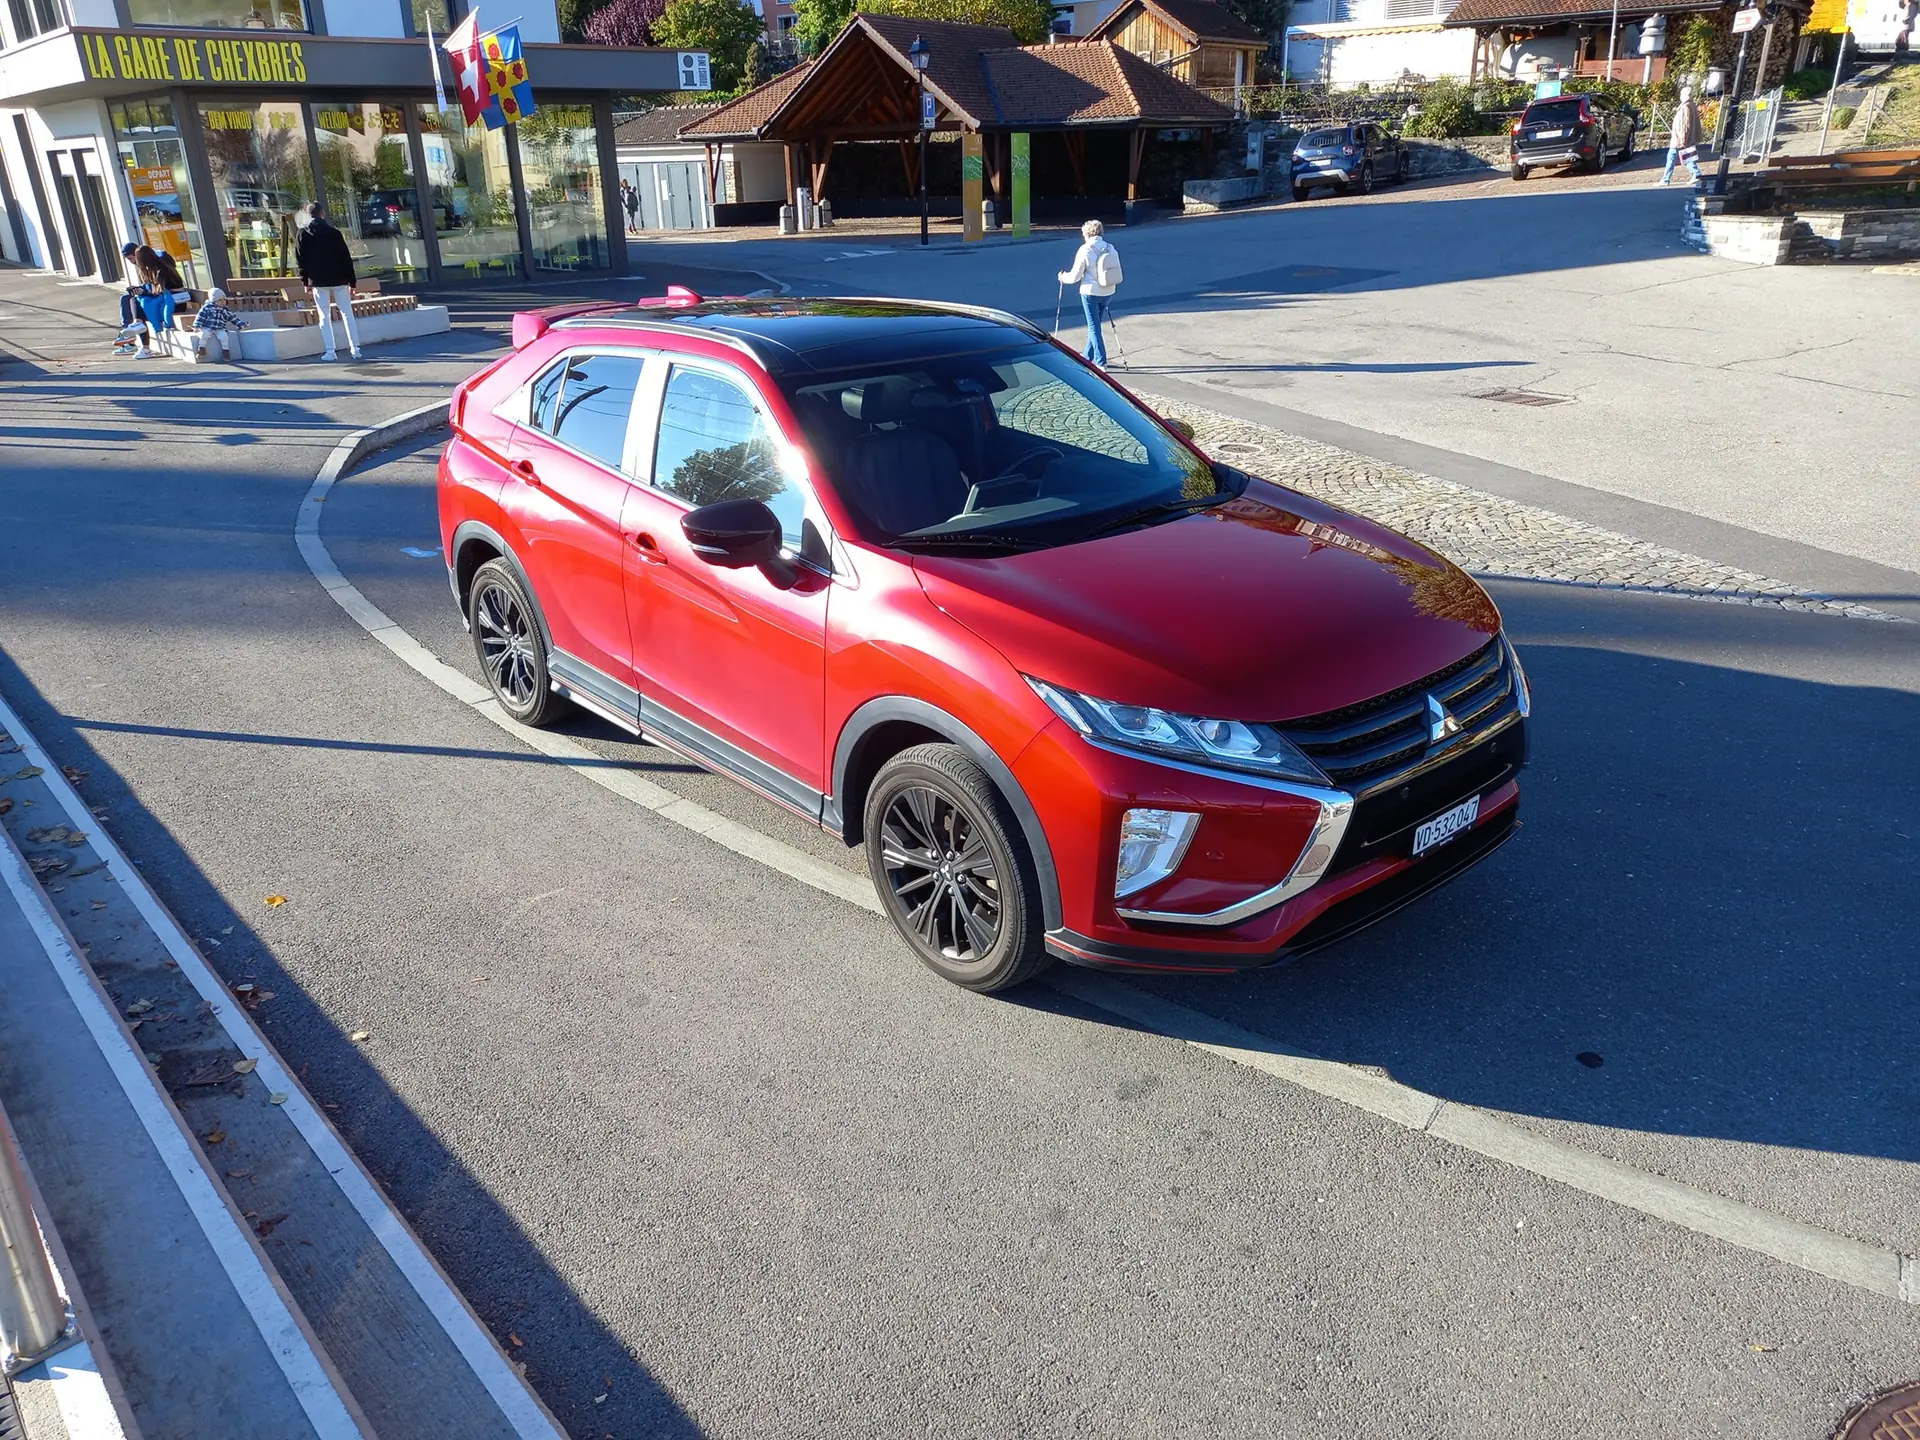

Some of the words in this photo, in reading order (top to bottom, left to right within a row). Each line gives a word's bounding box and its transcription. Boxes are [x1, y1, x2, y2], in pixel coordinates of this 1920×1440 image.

[82, 34, 116, 78] LA
[114, 36, 174, 80] GARE
[174, 38, 205, 81] DE
[205, 39, 307, 83] CHEXBRES
[926, 97, 932, 115] P
[317, 111, 349, 129] WELKOM
[368, 111, 399, 129] ようこそ
[152, 179, 174, 191] GARE
